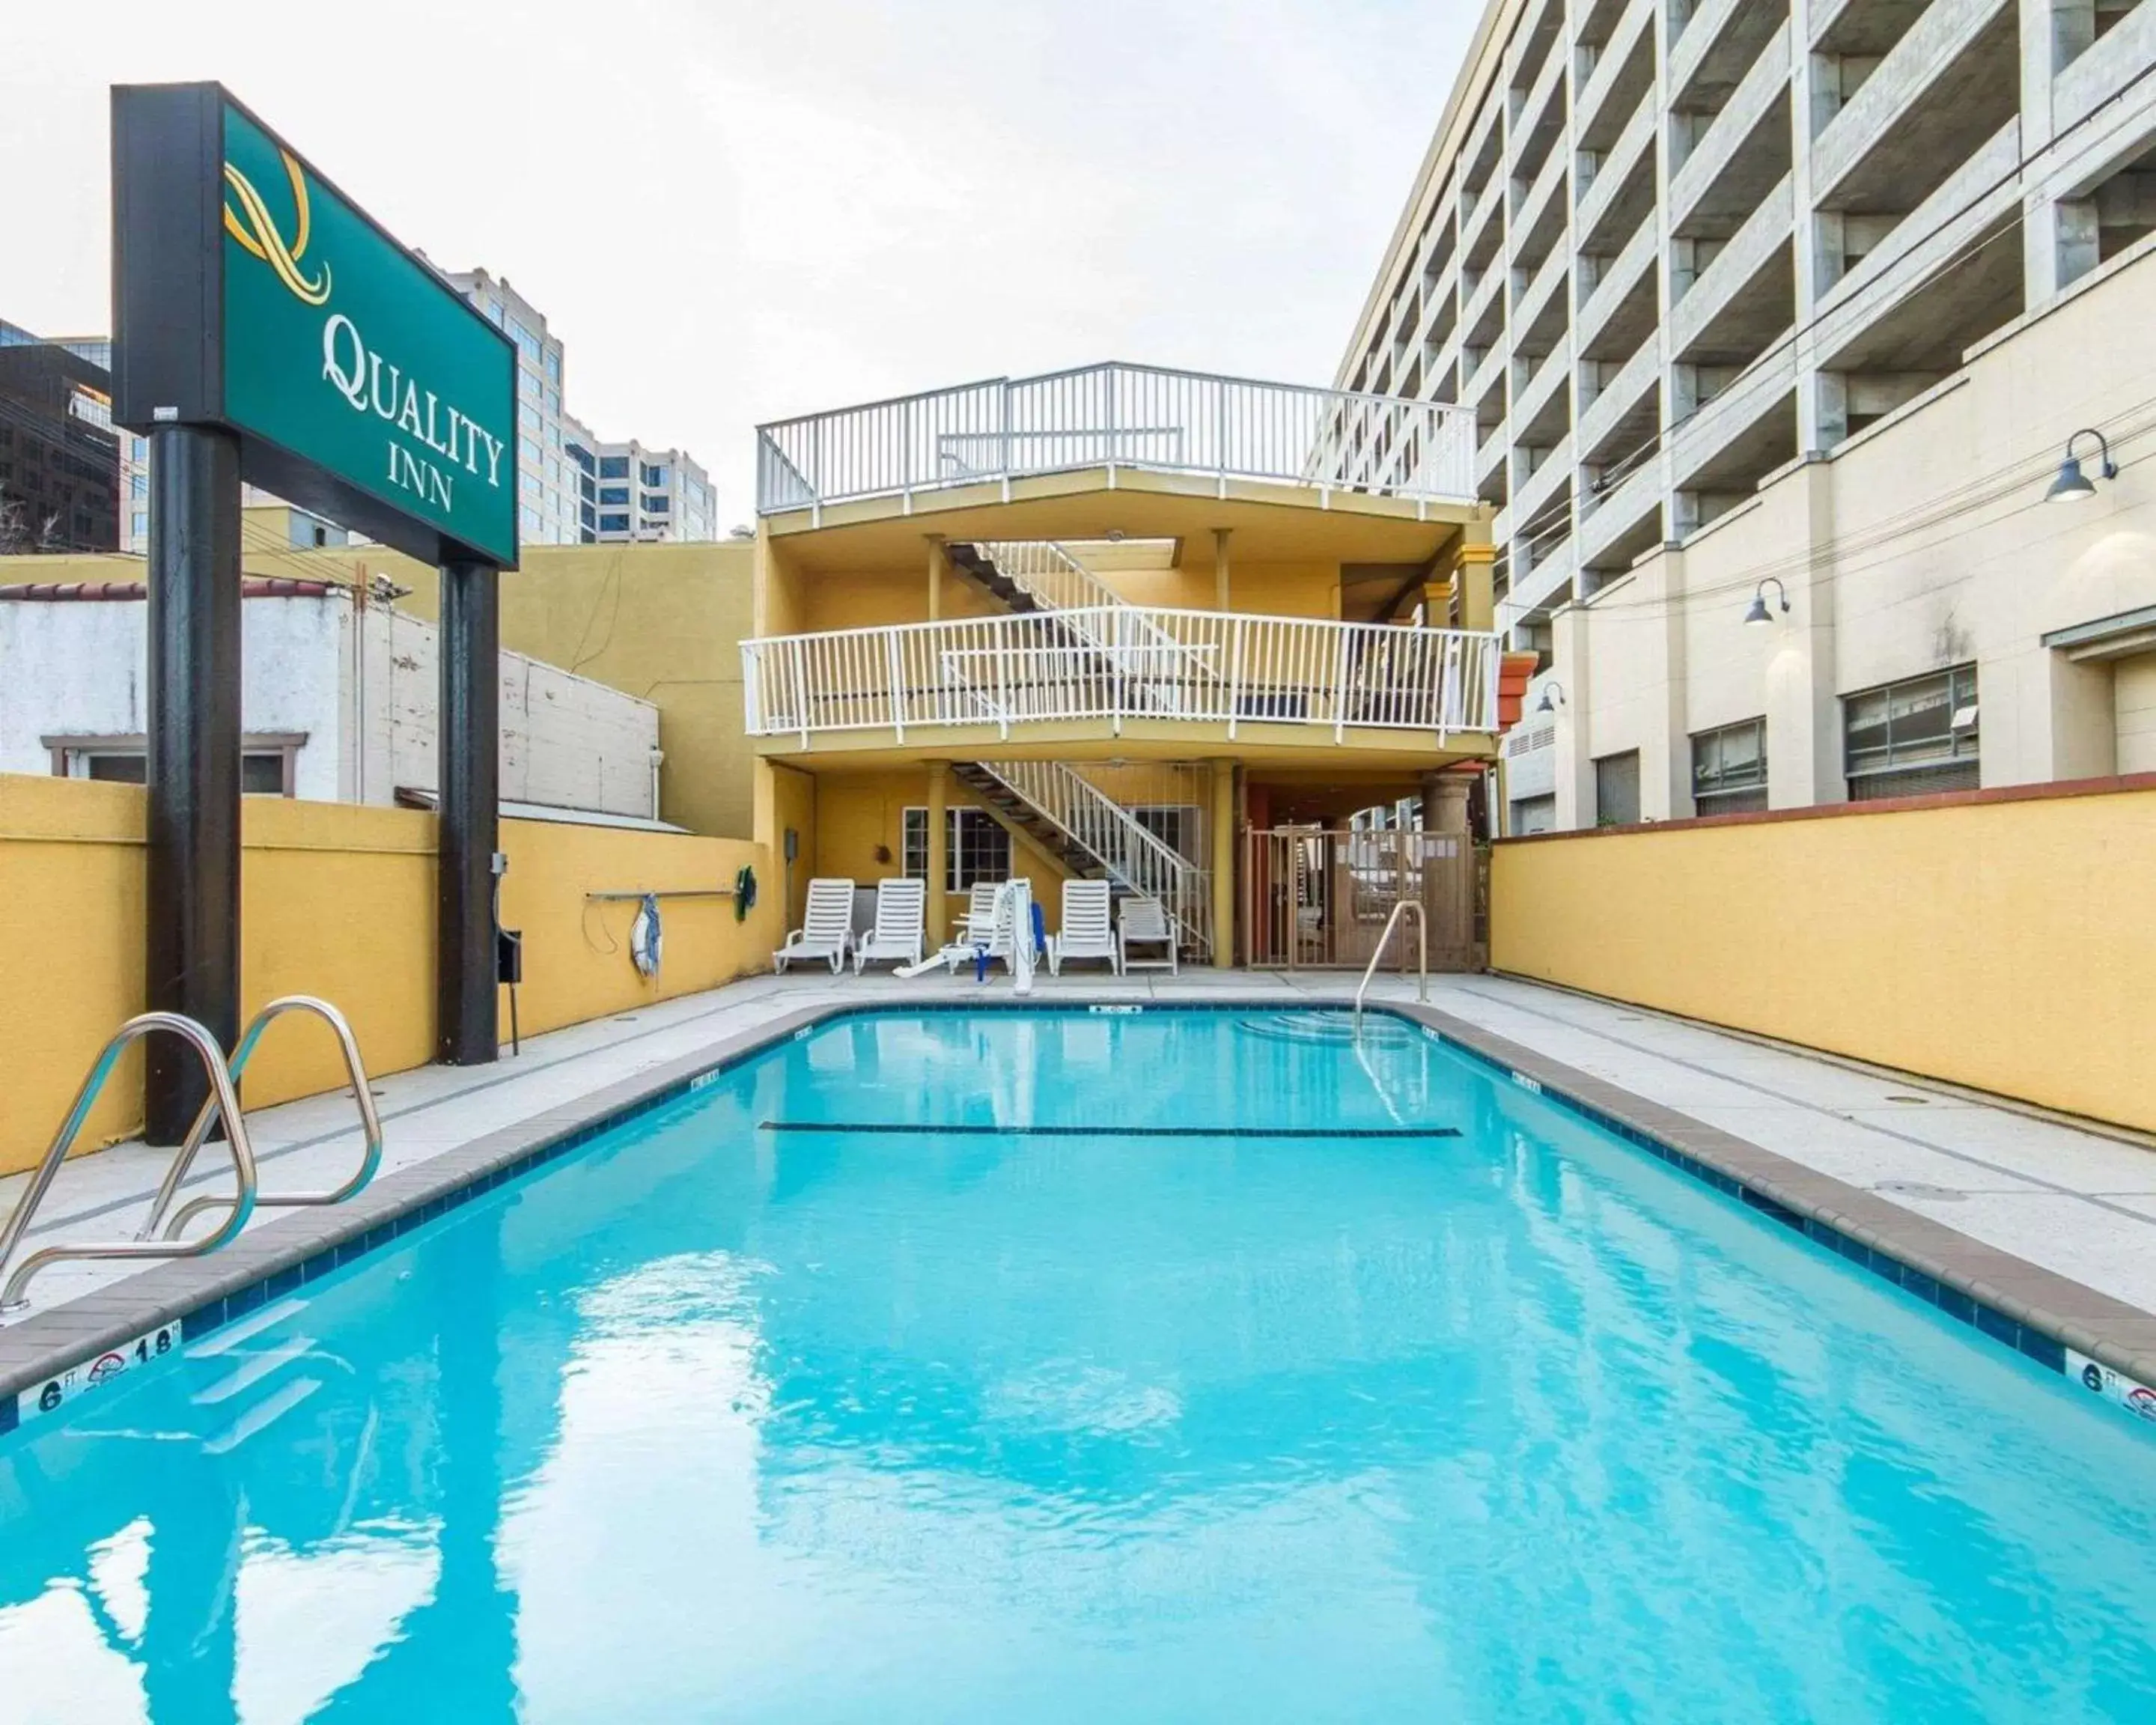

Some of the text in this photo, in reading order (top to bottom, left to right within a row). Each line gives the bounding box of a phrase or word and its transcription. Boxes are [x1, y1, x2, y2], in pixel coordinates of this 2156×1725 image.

[322, 314, 504, 487] QUALITY
[388, 441, 454, 513] INN
[39, 1381, 62, 1413] 6
[65, 1372, 76, 1387] FT
[2082, 1363, 2103, 1392] 6
